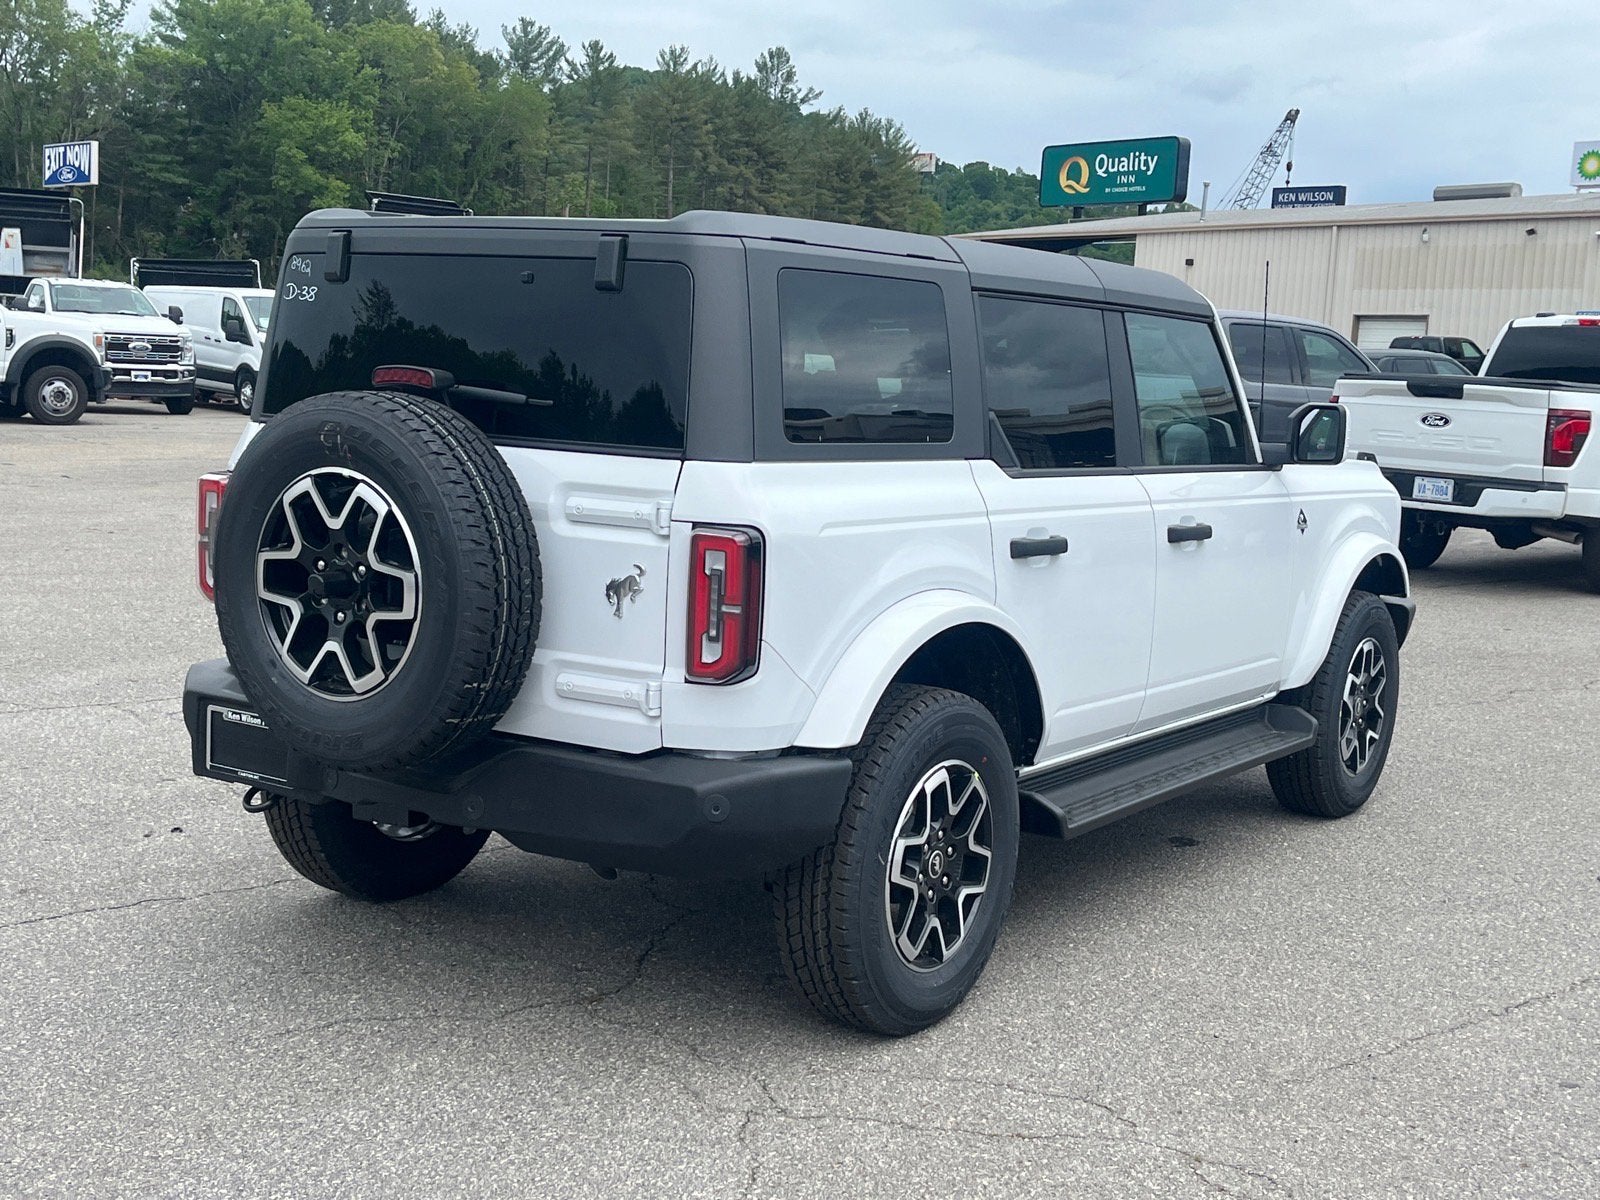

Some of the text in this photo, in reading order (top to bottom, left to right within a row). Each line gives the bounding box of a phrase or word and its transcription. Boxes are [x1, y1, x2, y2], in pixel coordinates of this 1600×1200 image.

[45, 144, 90, 181] EXIT NOW
[1095, 151, 1158, 177] Quality
[1059, 156, 1090, 194] Q
[1117, 174, 1136, 184] INN
[1278, 191, 1334, 202] KEN WILSON
[283, 282, 318, 302] D-38
[1424, 415, 1446, 426] Ford
[228, 710, 261, 725] Ken Wilson
